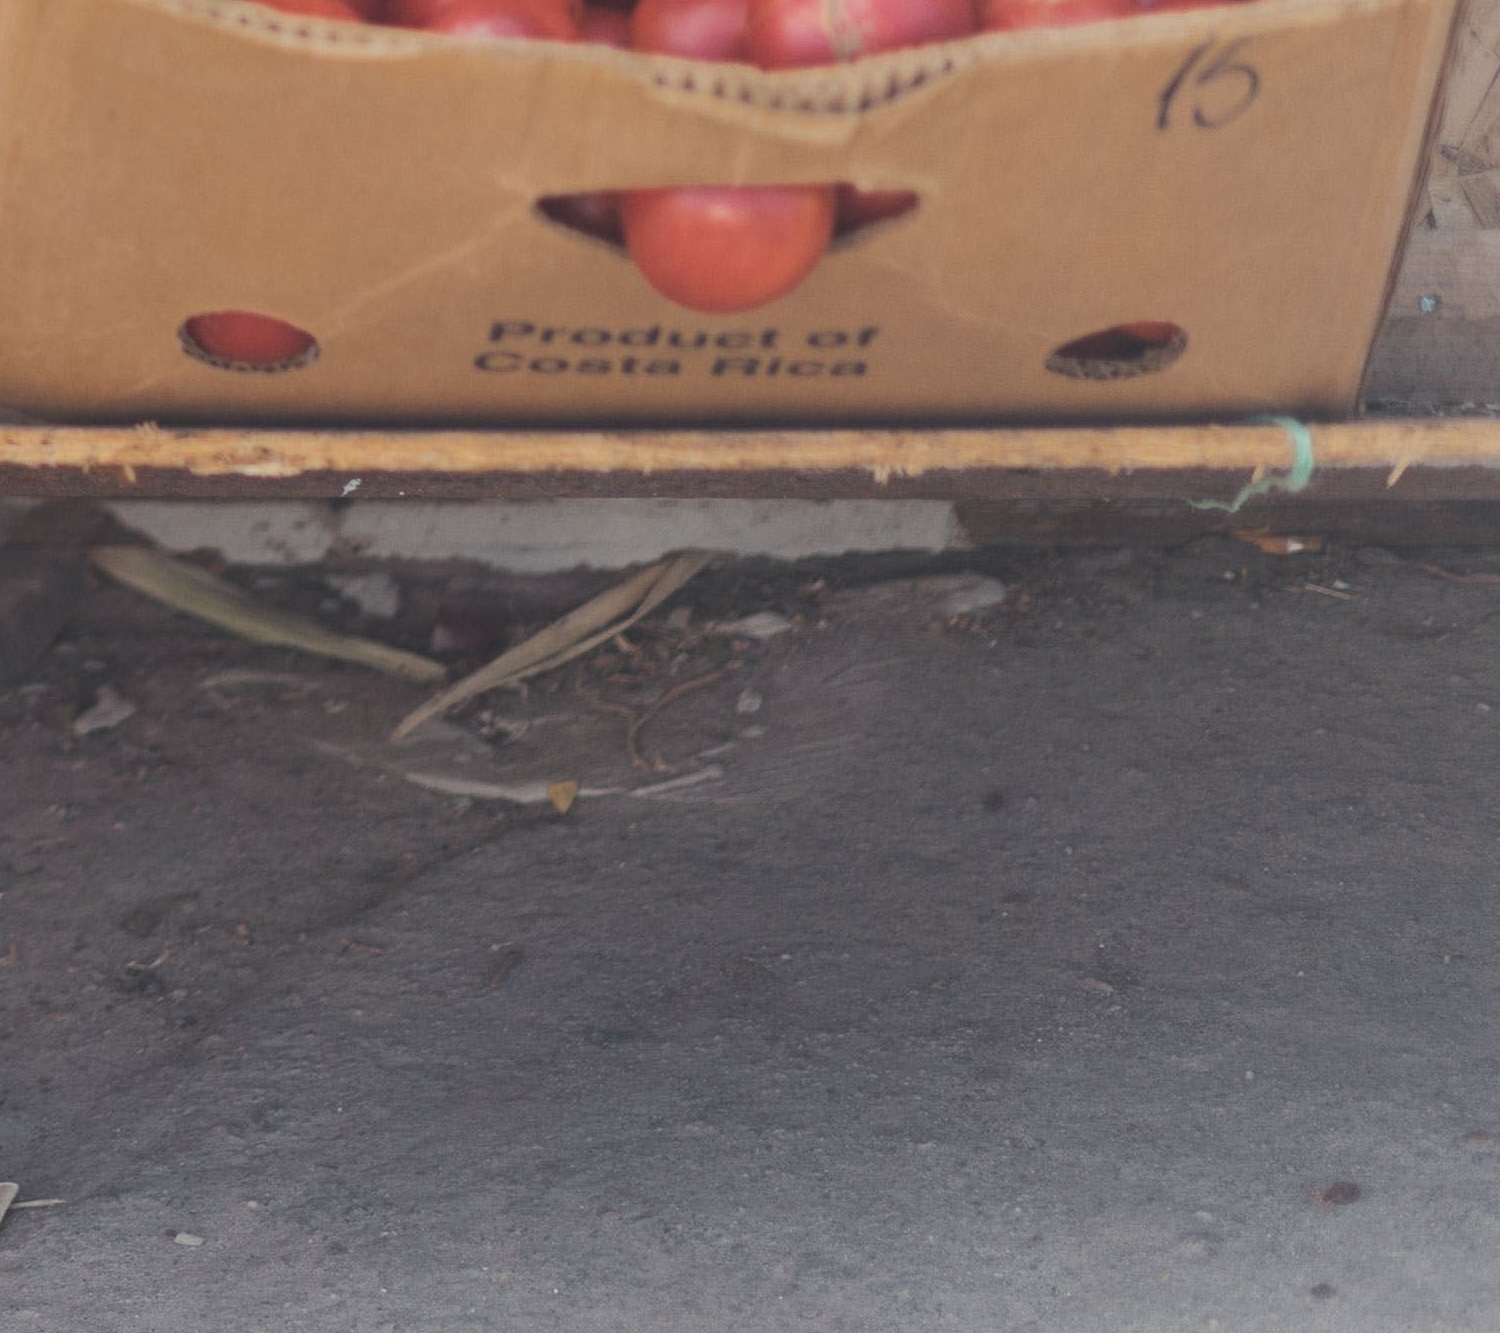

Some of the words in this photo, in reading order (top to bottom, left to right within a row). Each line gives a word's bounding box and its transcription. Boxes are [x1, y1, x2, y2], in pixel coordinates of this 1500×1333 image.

[488, 319, 781, 349] Product
[805, 324, 881, 349] of
[472, 350, 683, 376] Costa
[710, 355, 869, 378] Rica
